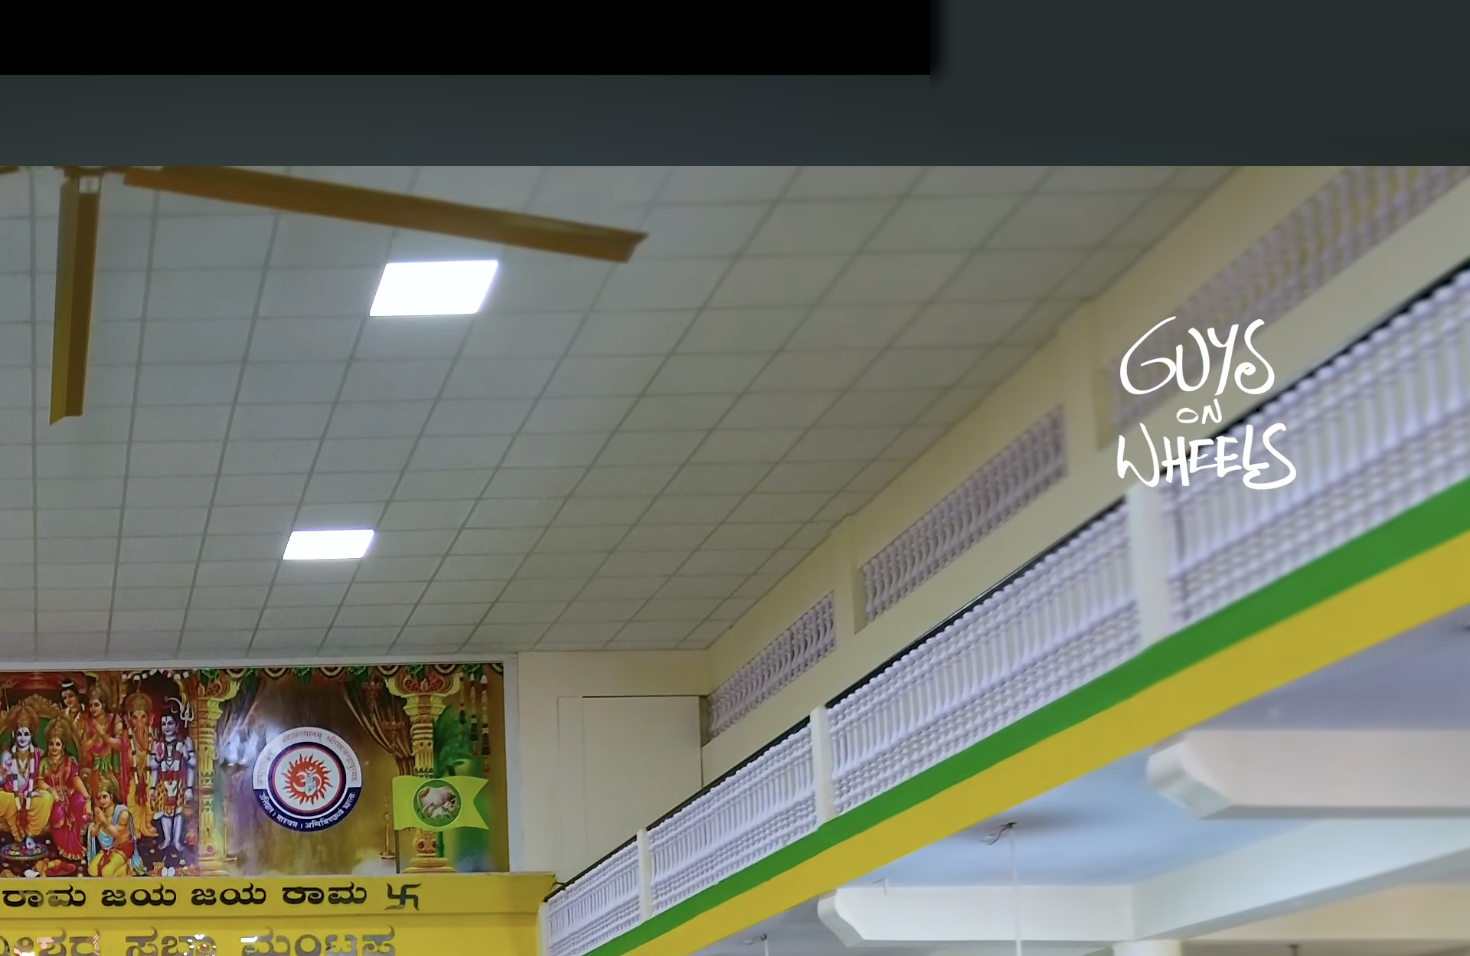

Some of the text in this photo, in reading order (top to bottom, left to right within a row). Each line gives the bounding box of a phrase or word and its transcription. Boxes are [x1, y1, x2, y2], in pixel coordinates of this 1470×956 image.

[2, 884, 86, 908] ರಾಮ
[101, 882, 177, 907] ಜಯ
[191, 882, 267, 906] ಜಯ
[282, 881, 368, 905] ರಾಮ
